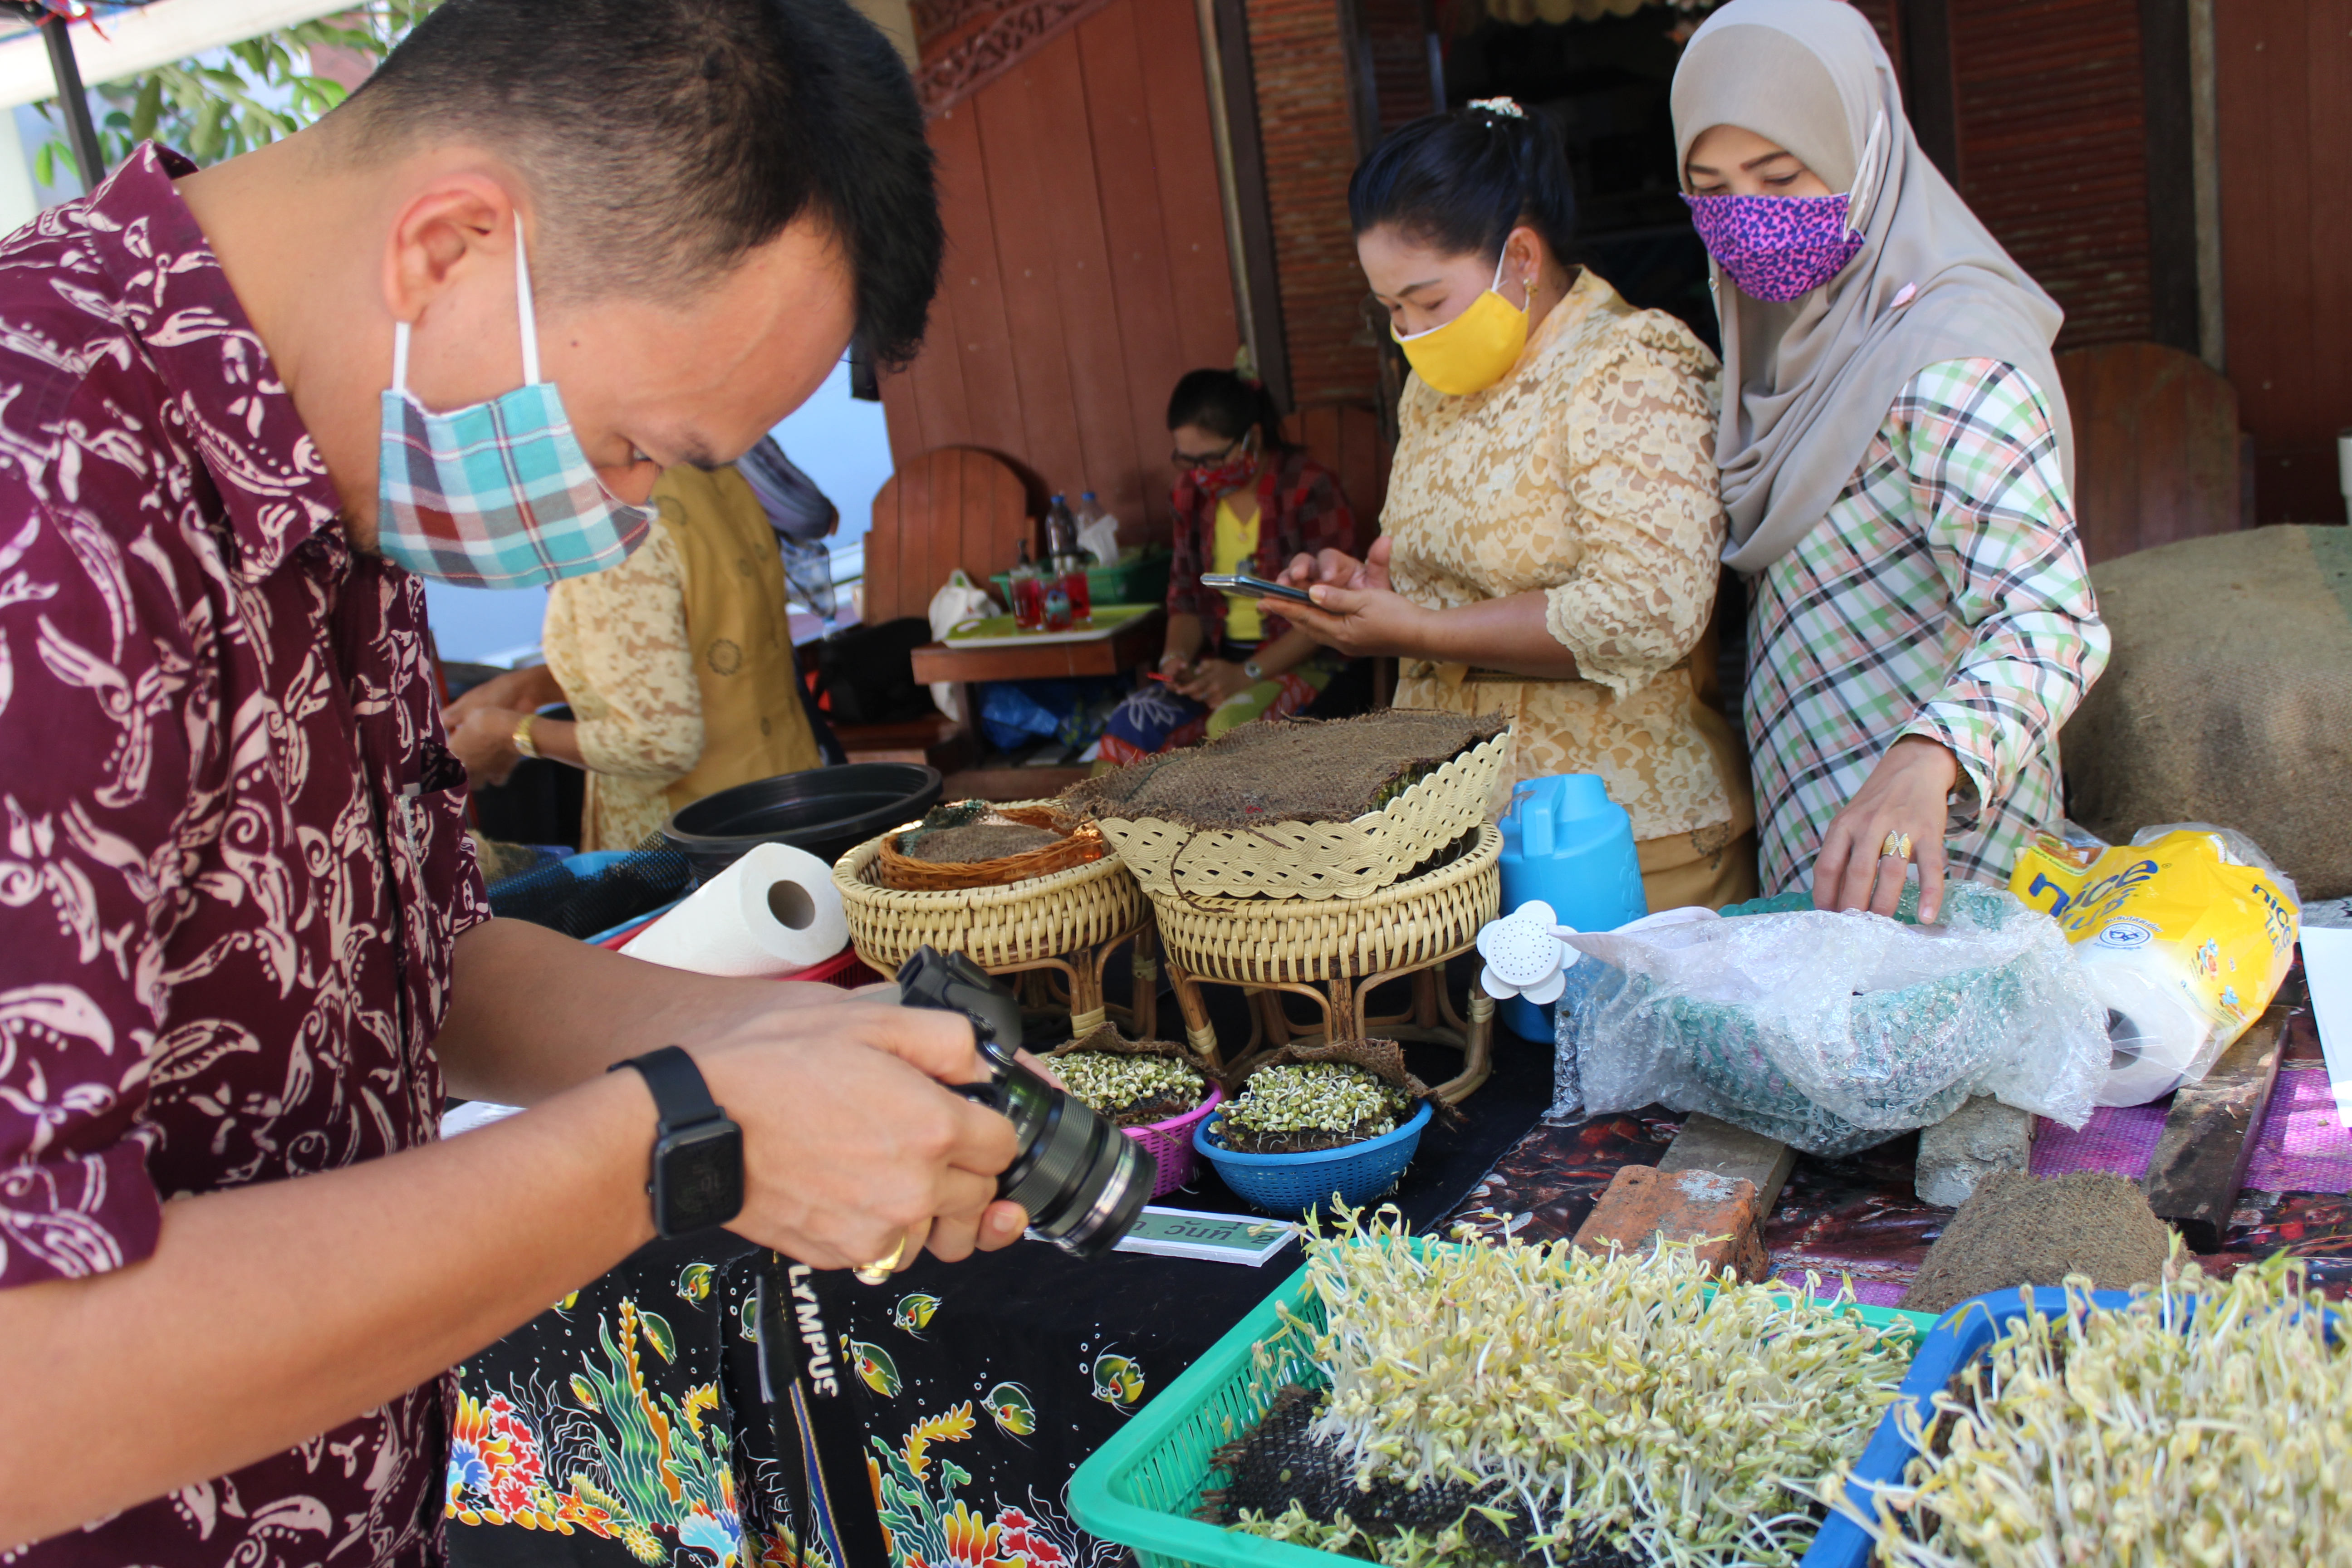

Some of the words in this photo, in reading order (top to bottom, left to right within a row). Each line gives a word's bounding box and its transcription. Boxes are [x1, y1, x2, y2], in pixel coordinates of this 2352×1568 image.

[2029, 860, 2158, 918] nice
[2252, 884, 2291, 948] nice
[1164, 1220, 1244, 1240] วันที่
[1251, 1235, 1275, 1245] 2
[788, 1264, 839, 1397] LYMPUS
